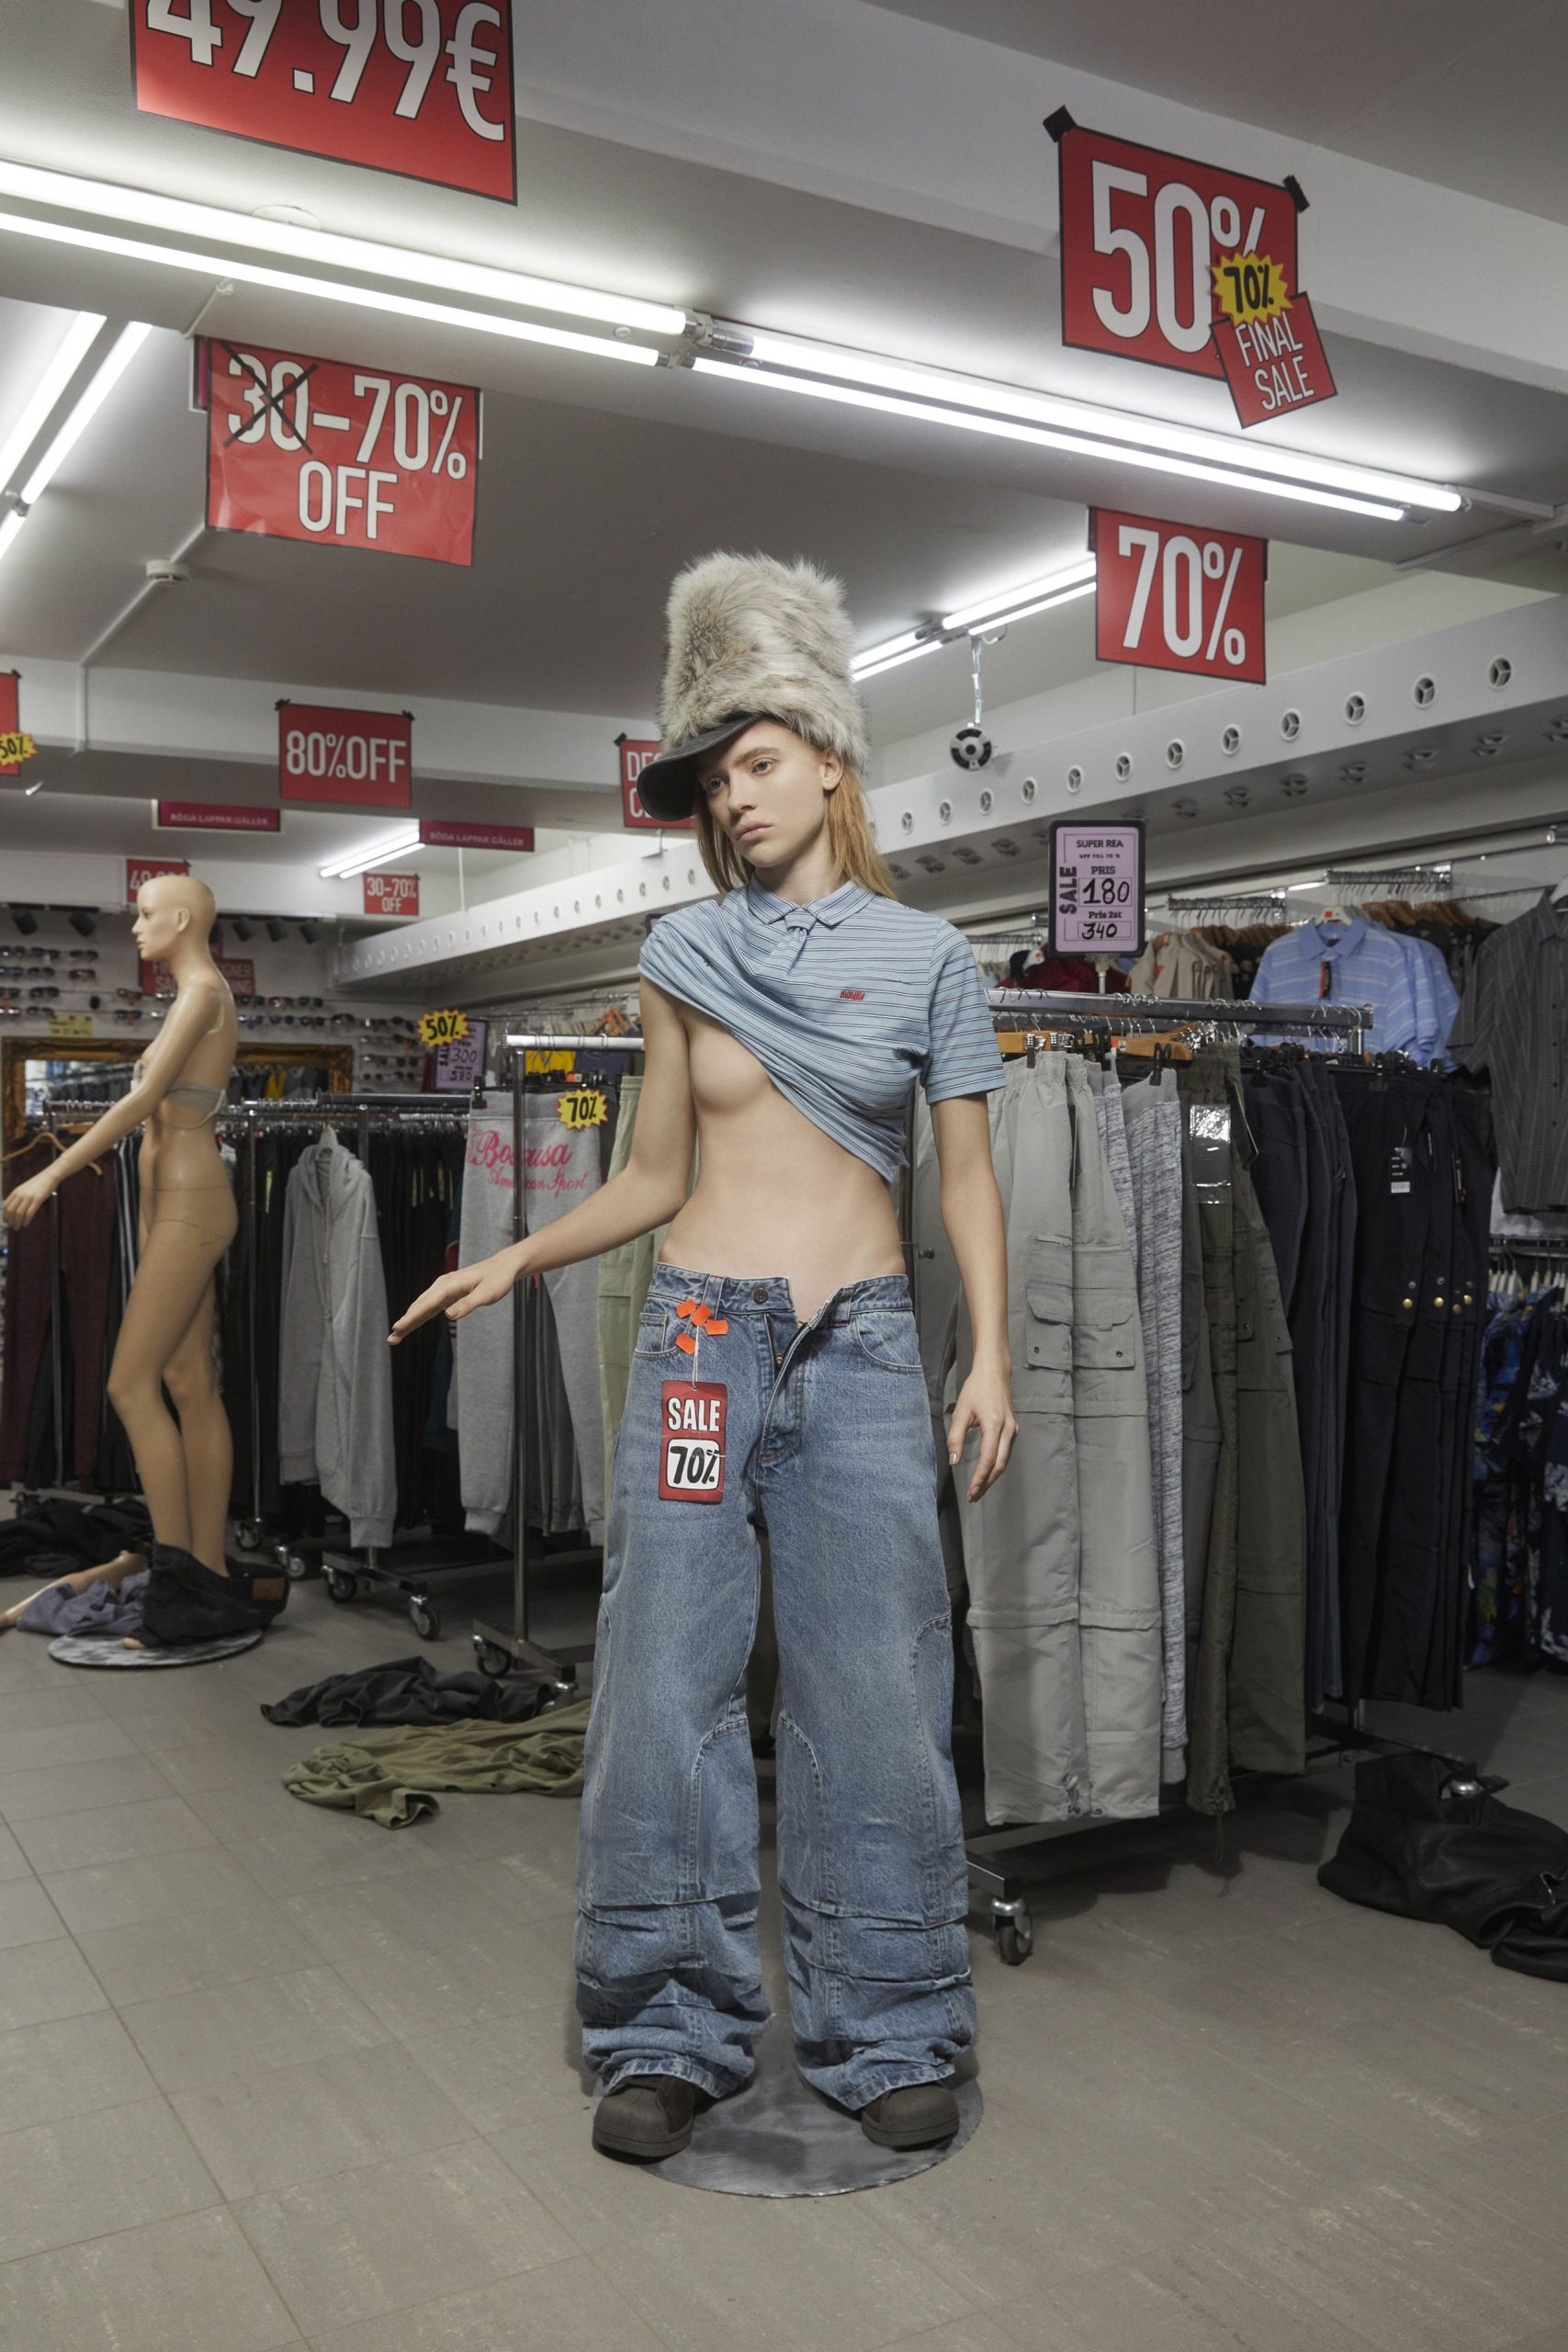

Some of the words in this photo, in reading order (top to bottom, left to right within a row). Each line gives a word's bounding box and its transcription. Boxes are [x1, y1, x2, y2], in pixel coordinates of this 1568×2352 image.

[1223, 264, 1274, 314] 70%
[1235, 310, 1303, 368] FINAL
[1254, 355, 1314, 411] SALE
[299, 460, 398, 539] OFF
[1118, 525, 1247, 667] 70%
[430, 831, 455, 841] RÖDA
[491, 835, 524, 846] GÄLLER
[1077, 839, 1104, 848] SUPER
[1106, 840, 1123, 848] REA
[1090, 865, 1116, 875] PRIS
[1059, 866, 1077, 914] SALE
[1082, 877, 1130, 905] 180
[381, 896, 402, 912] OFF
[1089, 910, 1107, 919] Pris
[1081, 922, 1118, 940] 340
[425, 1014, 459, 1040] 50%
[450, 1047, 478, 1063] 300
[566, 1096, 597, 1122] 70%
[667, 1396, 721, 1432] SALE
[670, 1445, 720, 1485] 70%
